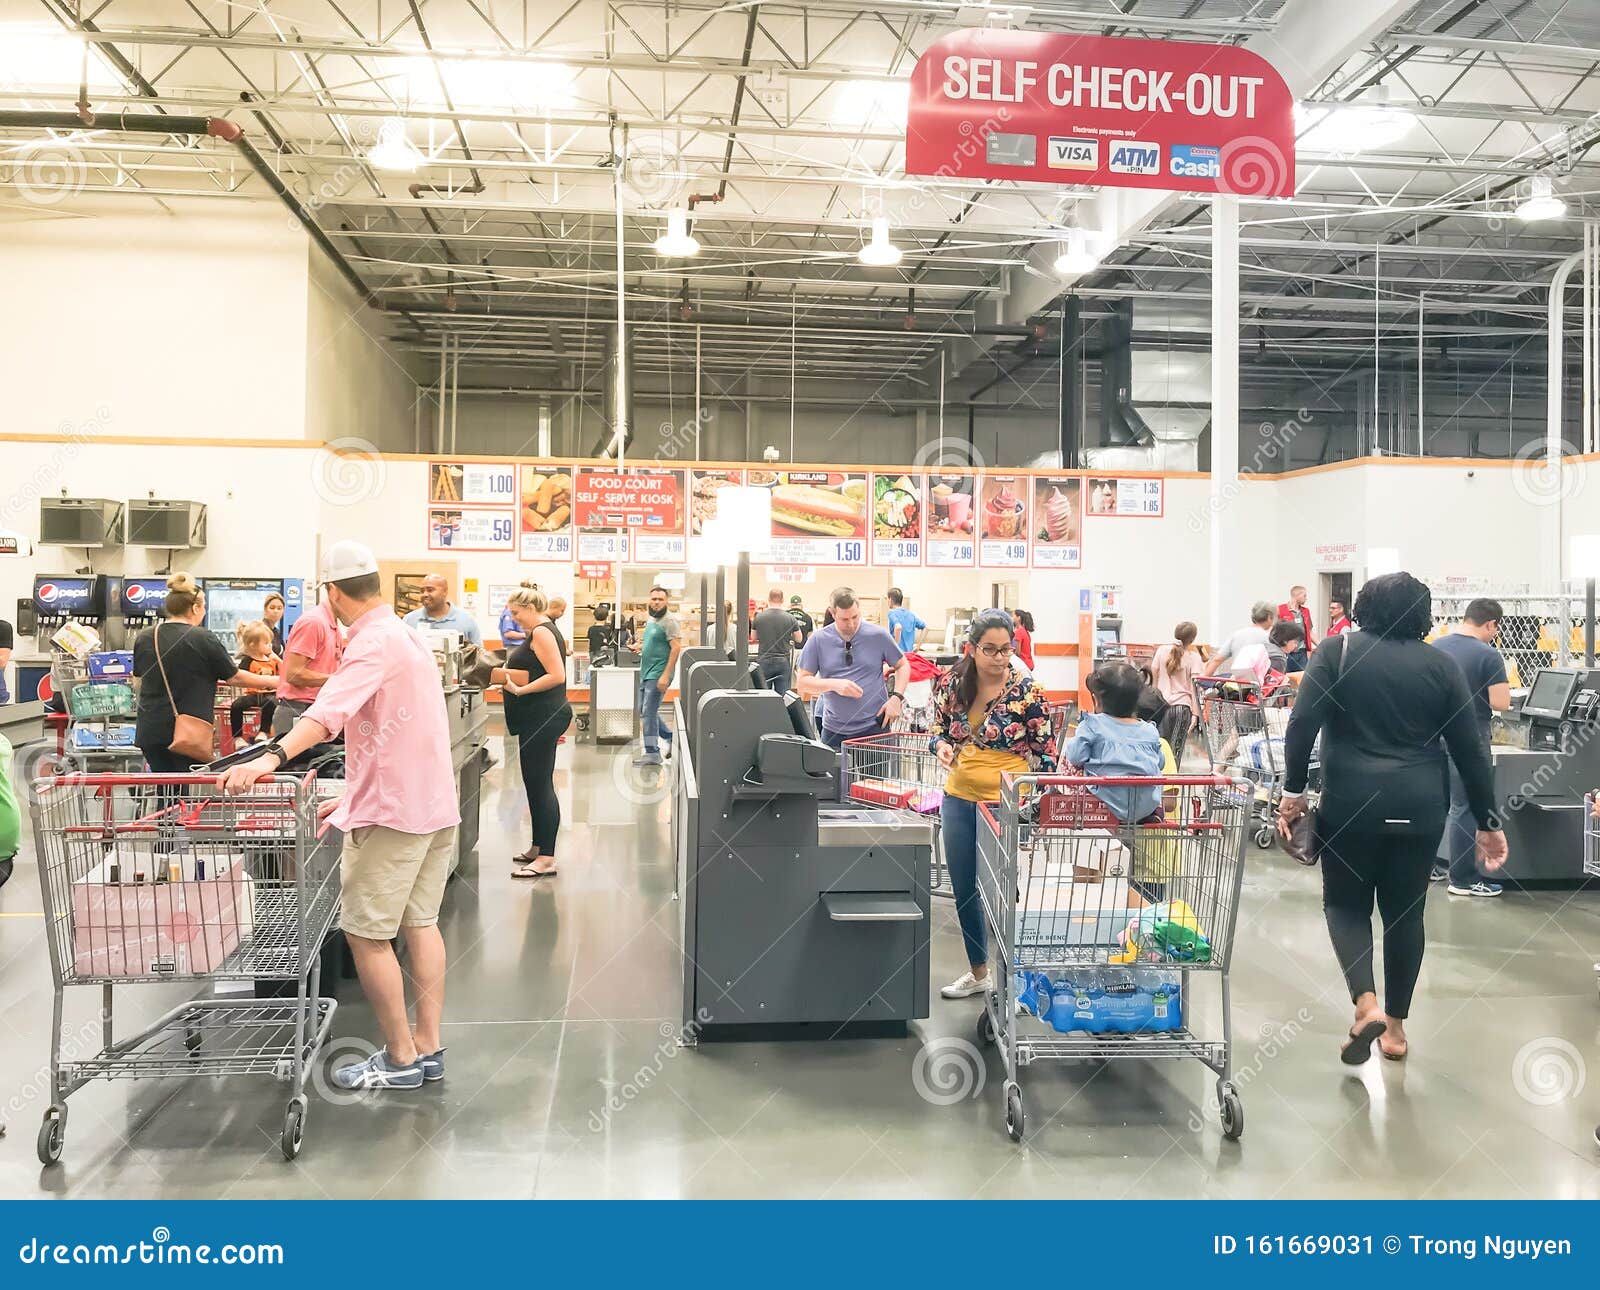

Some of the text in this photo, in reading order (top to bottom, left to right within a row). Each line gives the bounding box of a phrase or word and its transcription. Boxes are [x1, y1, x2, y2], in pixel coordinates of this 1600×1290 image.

[943, 55, 1264, 119] SELF CHECK-OUT
[1056, 145, 1092, 160] VISA
[1111, 147, 1158, 167] ATM
[1169, 157, 1220, 177] Cash
[488, 474, 512, 493] 1.00
[589, 477, 663, 490] FOOD COURT
[1143, 481, 1159, 494] 1.35
[640, 493, 674, 505] KIOSK
[488, 519, 512, 541] .59
[547, 536, 569, 552] 2.99
[607, 538, 628, 553] 3.9
[835, 542, 861, 561] 1.50
[897, 542, 918, 558] 3.99
[1006, 544, 1025, 559] 4.99
[1315, 543, 1357, 553] MERCHANDISE
[953, 546, 972, 560] 2.99
[1062, 549, 1078, 560] 2.99
[58, 587, 89, 599] pepsi
[145, 589, 170, 600] pep
